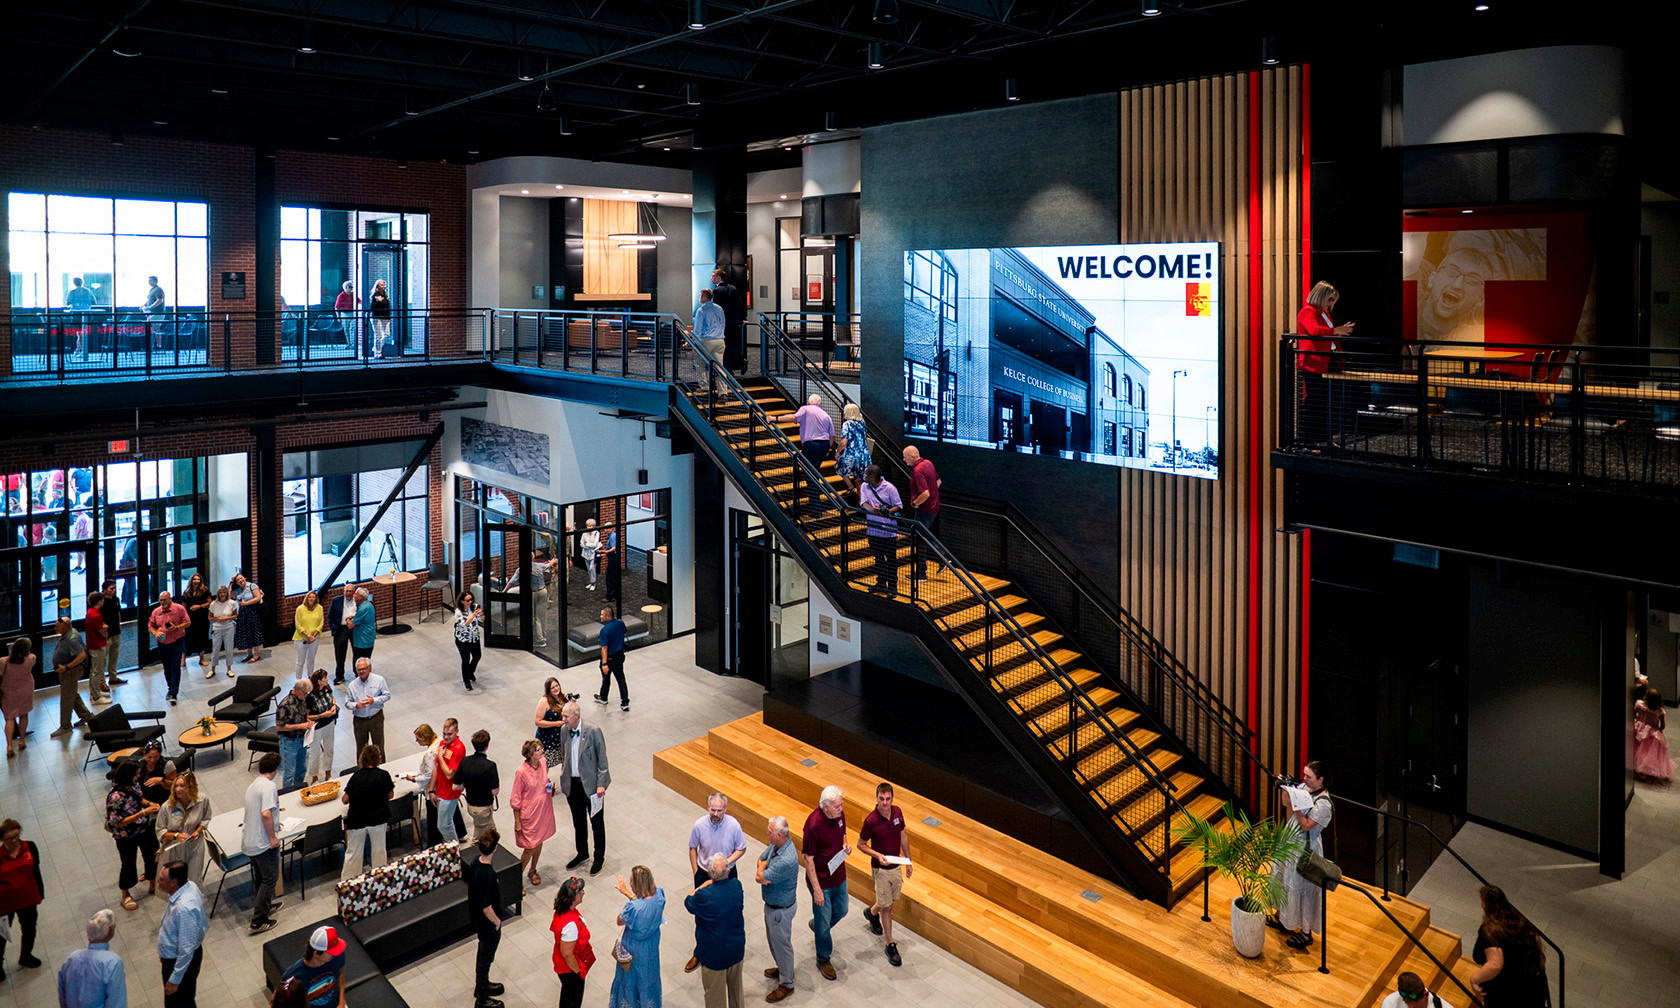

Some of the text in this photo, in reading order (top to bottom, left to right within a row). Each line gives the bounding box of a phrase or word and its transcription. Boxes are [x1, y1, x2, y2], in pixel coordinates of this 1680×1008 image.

[1057, 253, 1212, 279] WELCOME!
[995, 260, 1037, 298] PITTSBURG
[1038, 293, 1057, 313] STATE
[1003, 366, 1026, 383] KELCE
[1027, 375, 1054, 393] COLLEGE
[1054, 386, 1062, 396] OF
